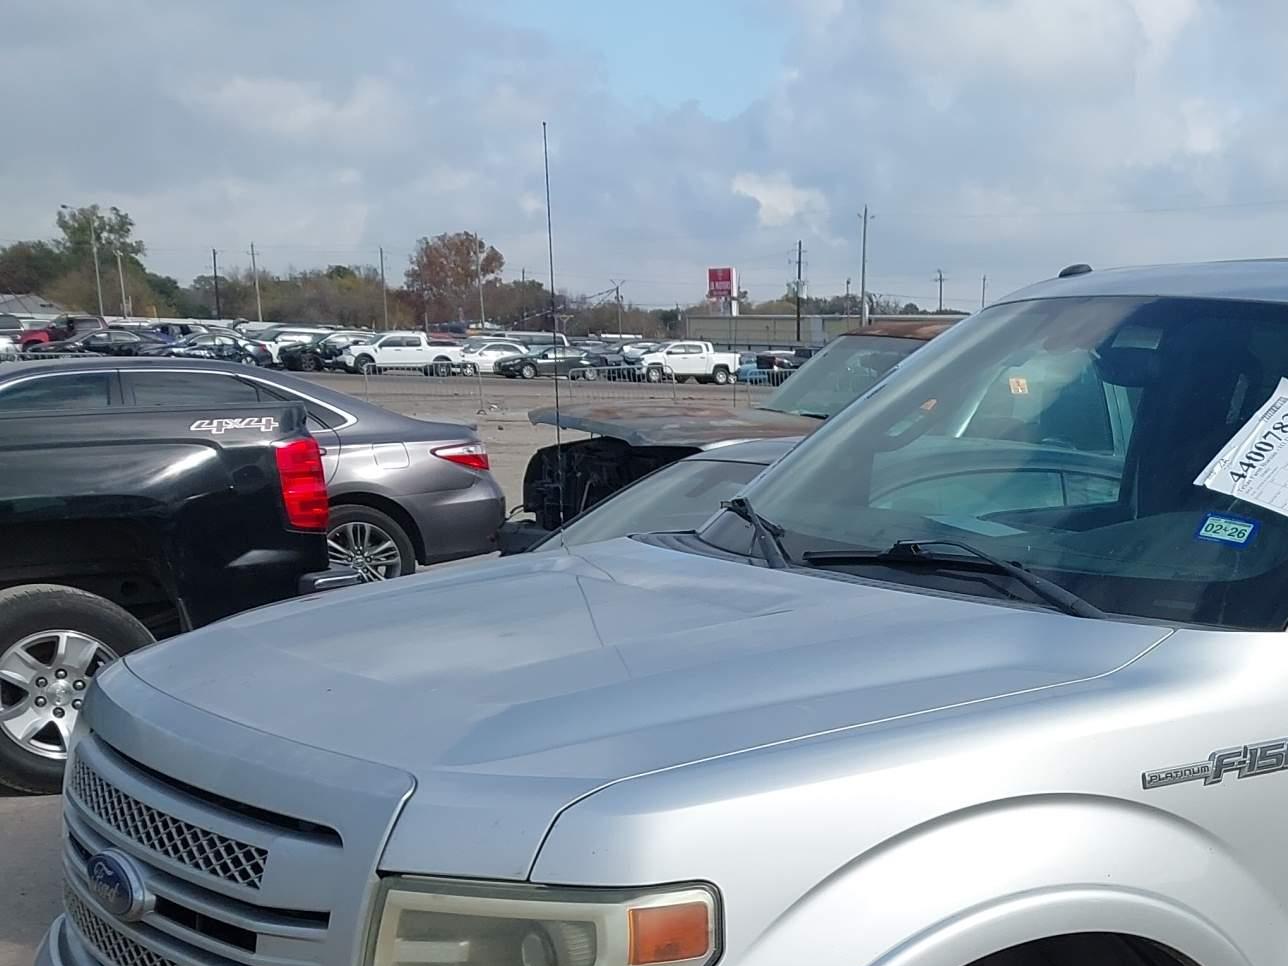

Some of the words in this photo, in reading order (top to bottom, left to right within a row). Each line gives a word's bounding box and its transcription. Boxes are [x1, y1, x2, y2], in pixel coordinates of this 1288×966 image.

[1204, 523, 1223, 534] 02
[1227, 527, 1248, 539] 26
[1149, 764, 1211, 785] PLATINUM
